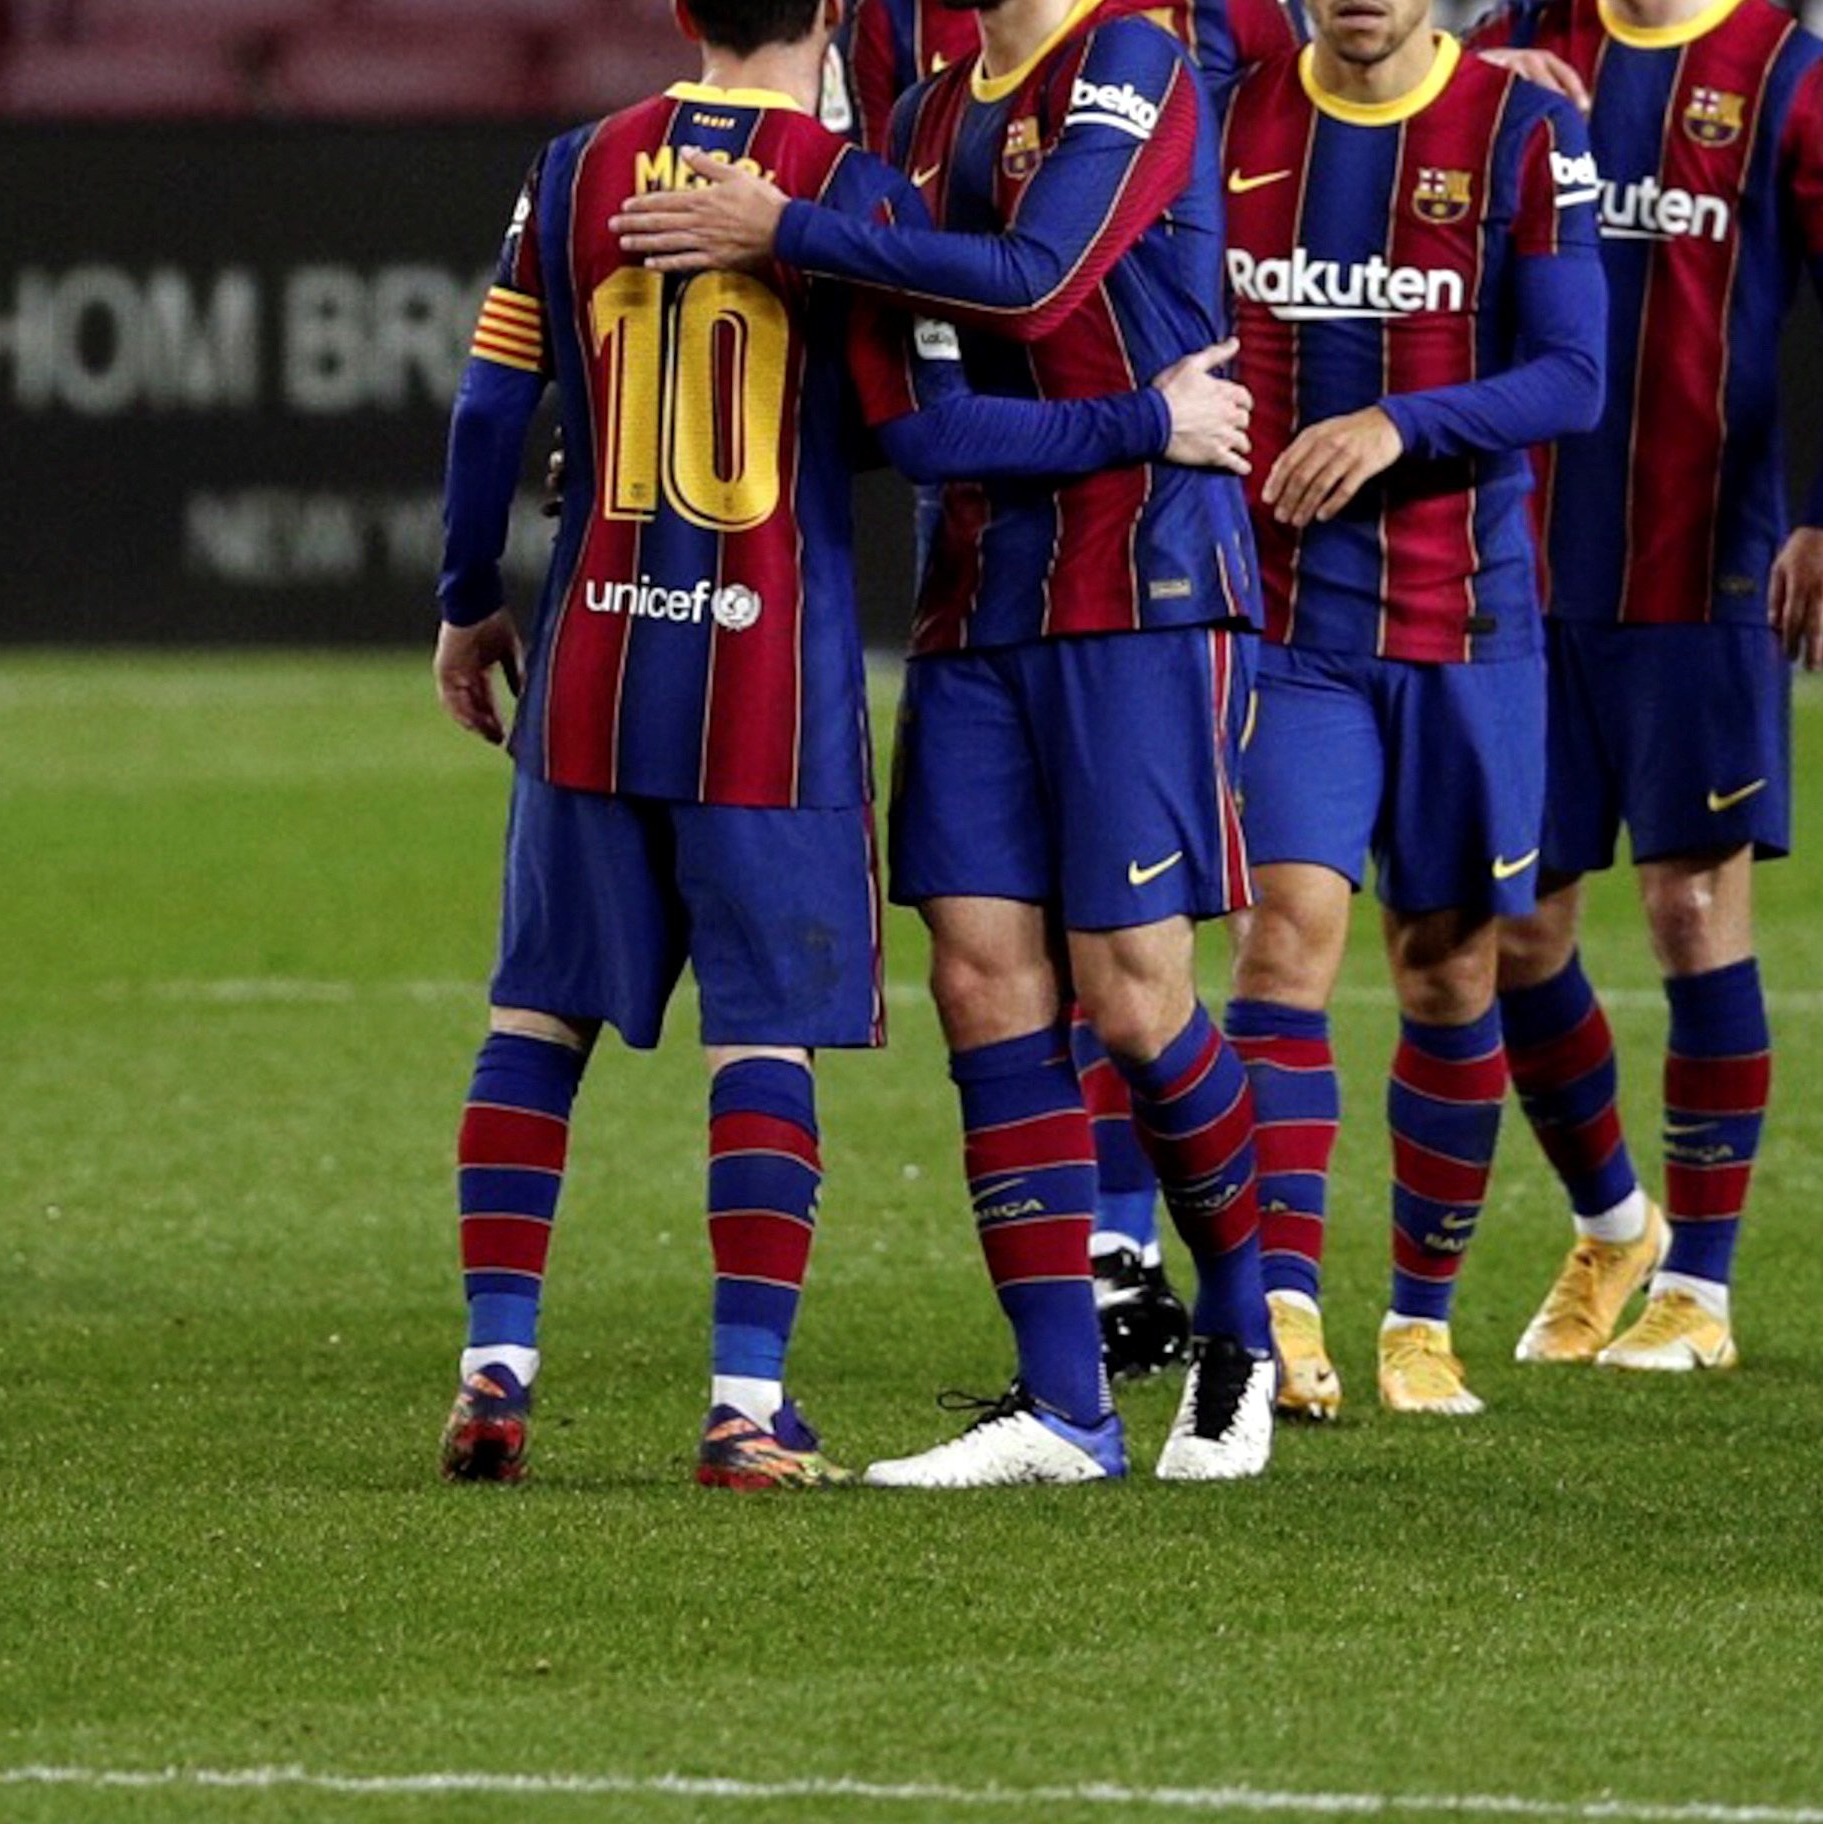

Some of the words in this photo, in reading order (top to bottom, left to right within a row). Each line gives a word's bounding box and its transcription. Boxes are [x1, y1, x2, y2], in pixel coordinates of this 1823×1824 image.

[1071, 79, 1159, 130] beko
[1226, 246, 1464, 312] Rakuten
[587, 266, 790, 533] 10
[585, 574, 712, 624] unicef
